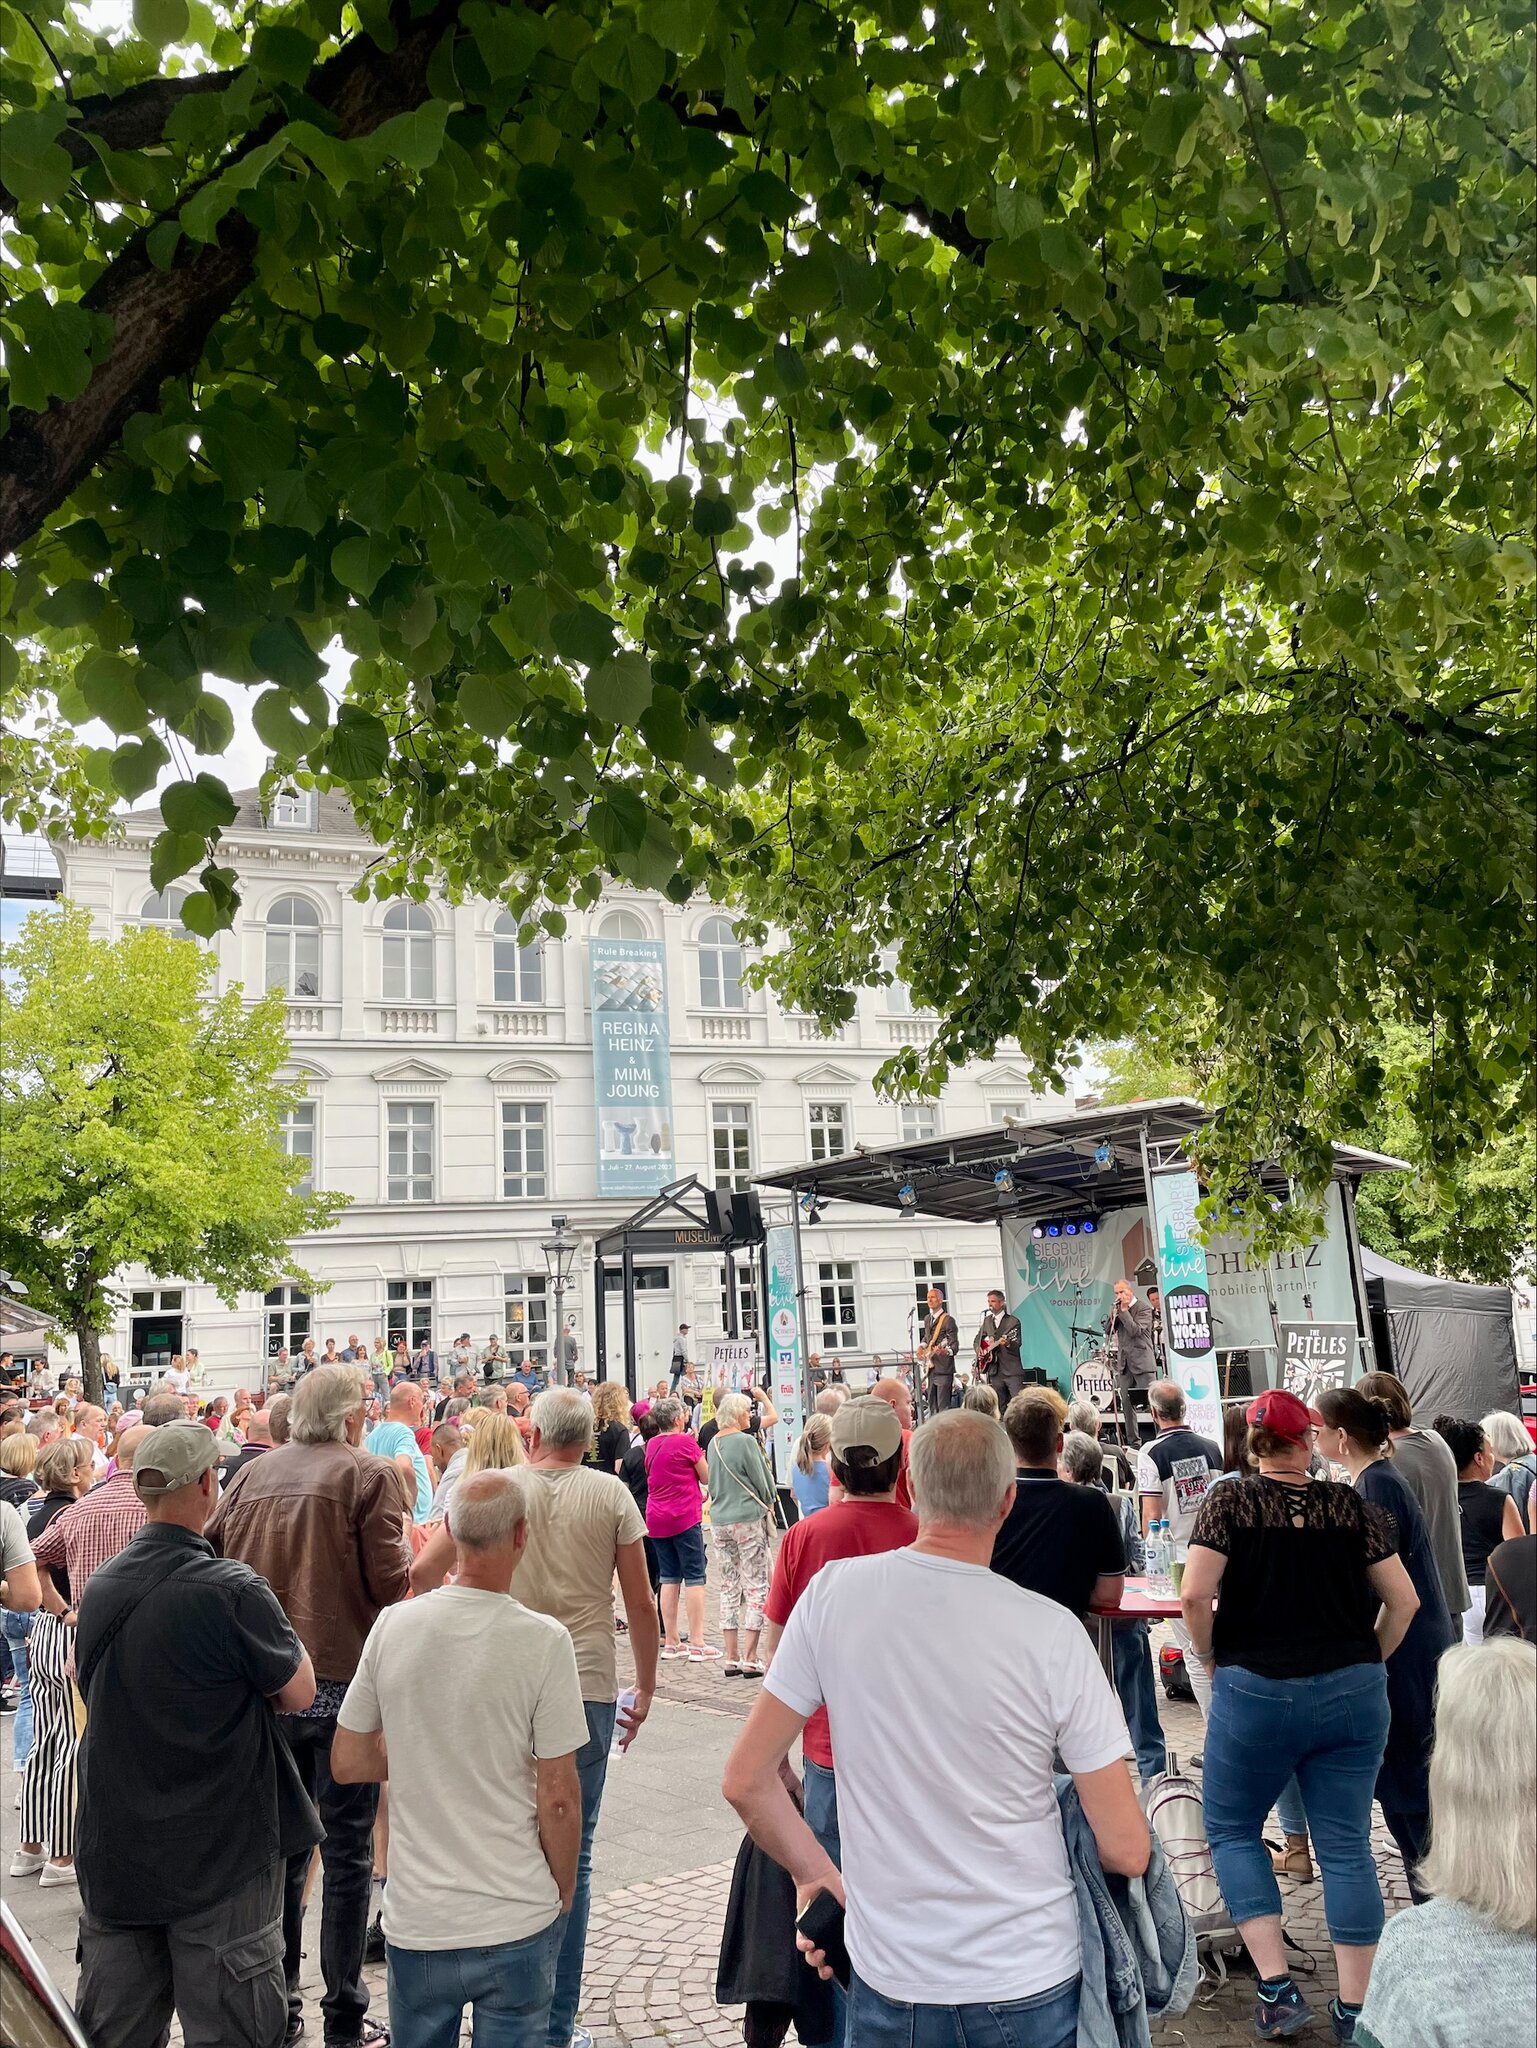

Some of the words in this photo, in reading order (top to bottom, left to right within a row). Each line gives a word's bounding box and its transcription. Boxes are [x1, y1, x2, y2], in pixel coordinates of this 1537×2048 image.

[598, 947, 617, 956] Rule
[620, 948, 657, 959] Breaking
[602, 1022, 660, 1035] REGINA
[609, 1038, 654, 1052] HEINZ
[629, 1056, 637, 1064] &
[614, 1068, 651, 1081] MIMI
[606, 1084, 660, 1098] JOUNG
[1170, 1180, 1189, 1255] SIEGBURG
[1033, 1239, 1094, 1257] SIEGBURG
[1160, 1254, 1205, 1278] live
[1026, 1258, 1095, 1292] live
[1168, 1293, 1207, 1309] IMMER
[1170, 1307, 1208, 1325] MITT
[1172, 1324, 1210, 1339] WOCHS
[1310, 1329, 1320, 1337] THE
[1174, 1339, 1186, 1350] AB
[1185, 1338, 1195, 1349] 18
[1194, 1337, 1211, 1348] UHR
[1287, 1332, 1347, 1359] PETELES
[714, 1346, 749, 1363] PETELES
